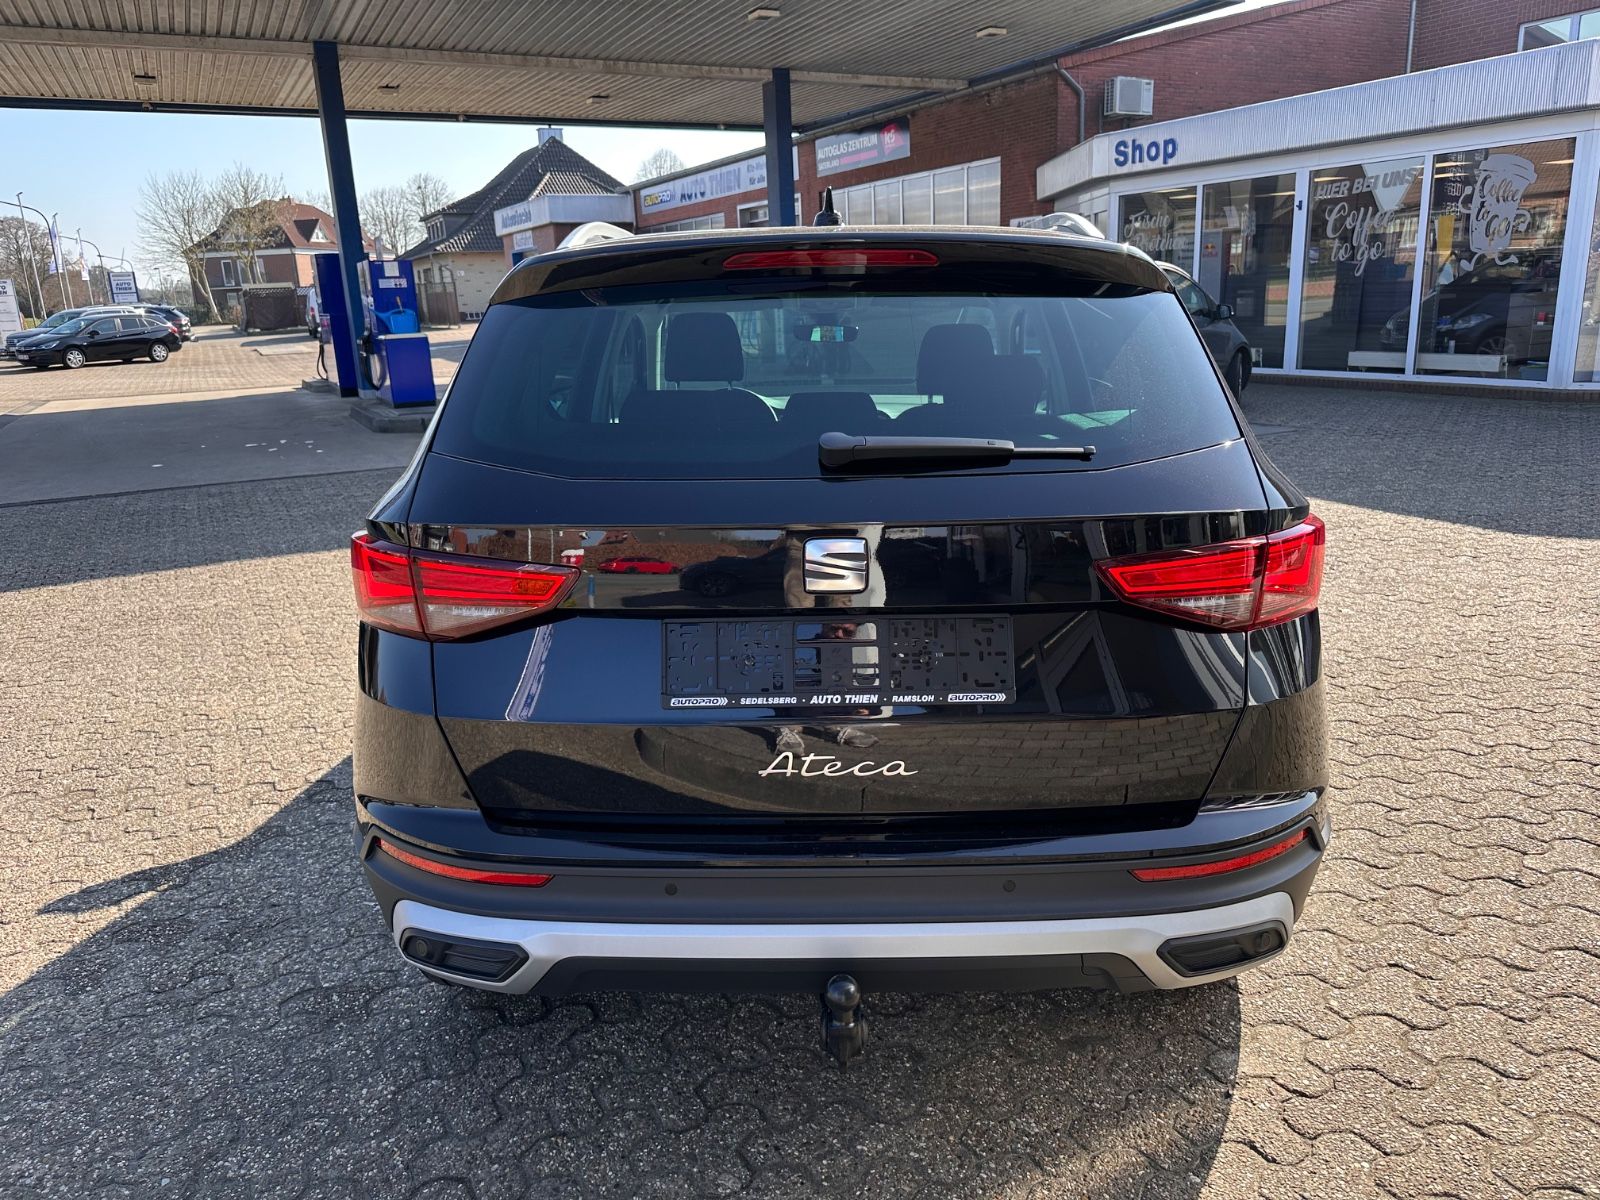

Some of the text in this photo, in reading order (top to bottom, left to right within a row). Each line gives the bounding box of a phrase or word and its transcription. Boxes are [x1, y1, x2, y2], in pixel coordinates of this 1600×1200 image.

[817, 133, 878, 160] AUTOGLAS ZENTRUM
[1114, 137, 1179, 167] Shop
[680, 175, 706, 204] AUTO
[709, 167, 742, 197] THIEN
[1315, 168, 1416, 198] HIER BEI UNS
[1479, 173, 1519, 204] Coffee
[1325, 201, 1396, 247] Coffee
[1330, 238, 1384, 277] to go
[740, 697, 797, 705] SEDELSBERG
[810, 695, 842, 704] AUTO
[845, 694, 878, 703] THIEN
[758, 751, 918, 778] Ateca
